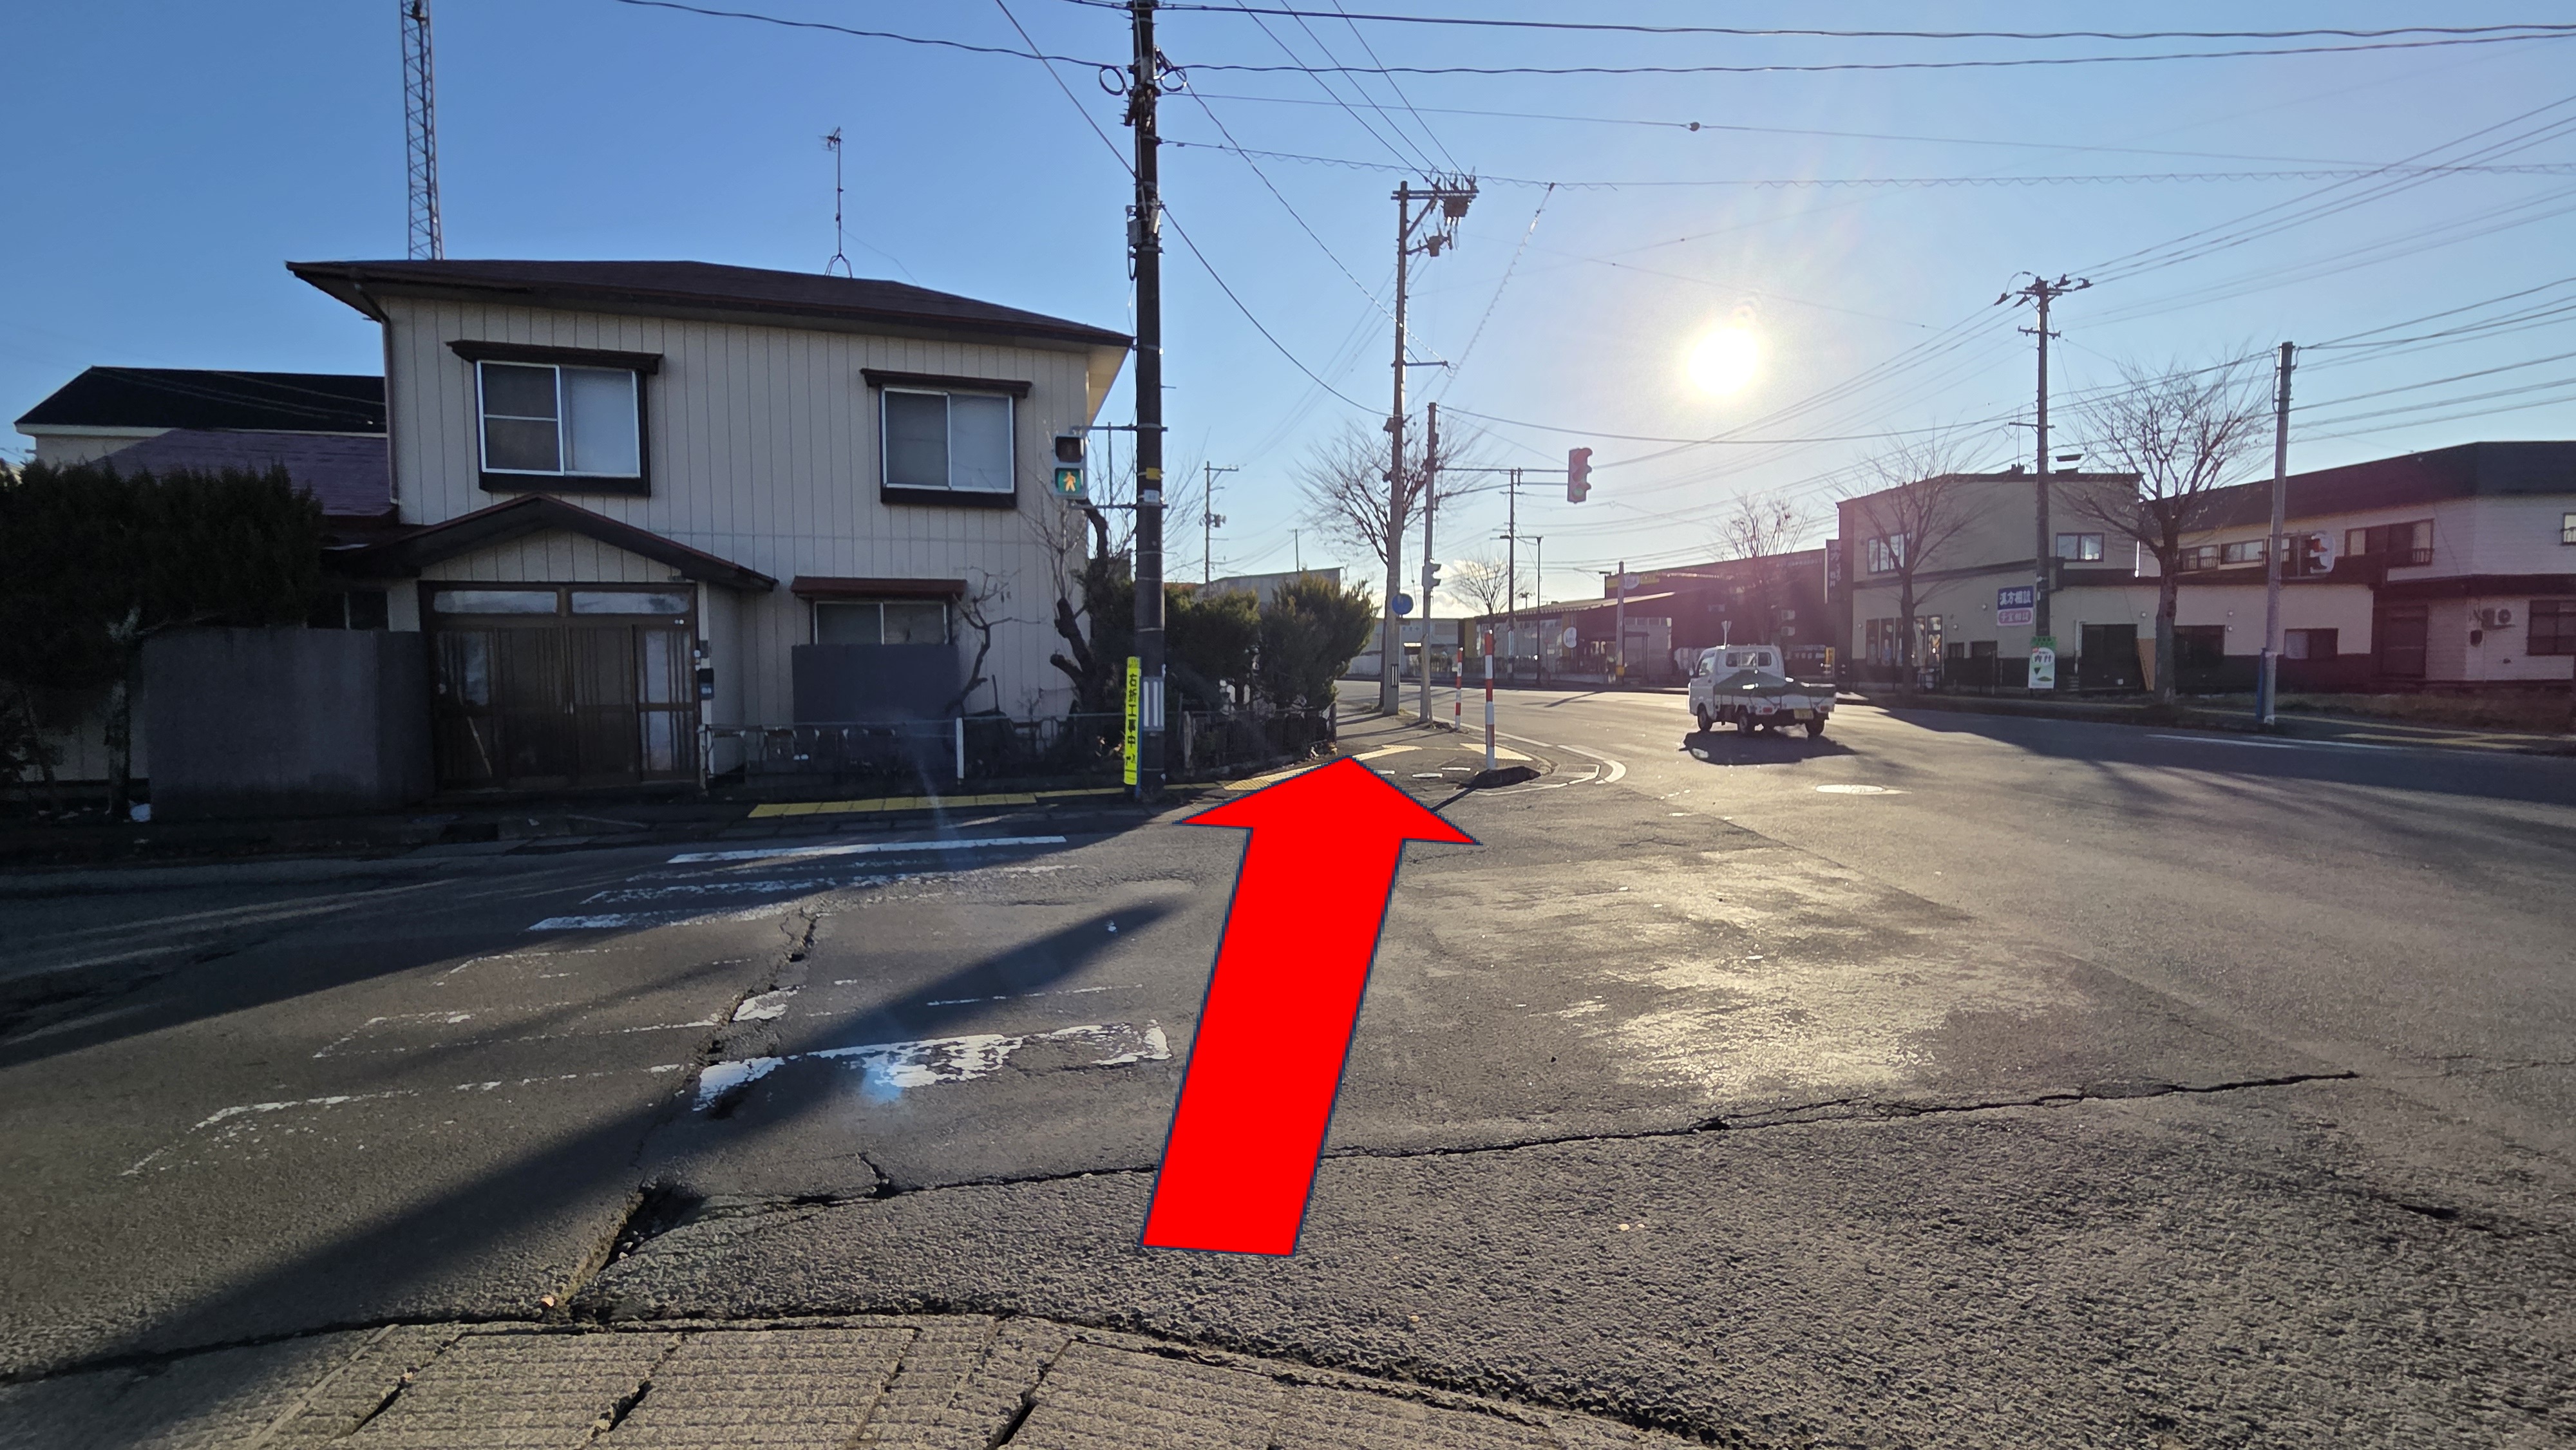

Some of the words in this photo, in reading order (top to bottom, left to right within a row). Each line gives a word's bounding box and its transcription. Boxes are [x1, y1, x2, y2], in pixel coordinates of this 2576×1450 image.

[2000, 590, 2031, 606] 漢方相談
[1127, 673, 1137, 749] 右折工事中
